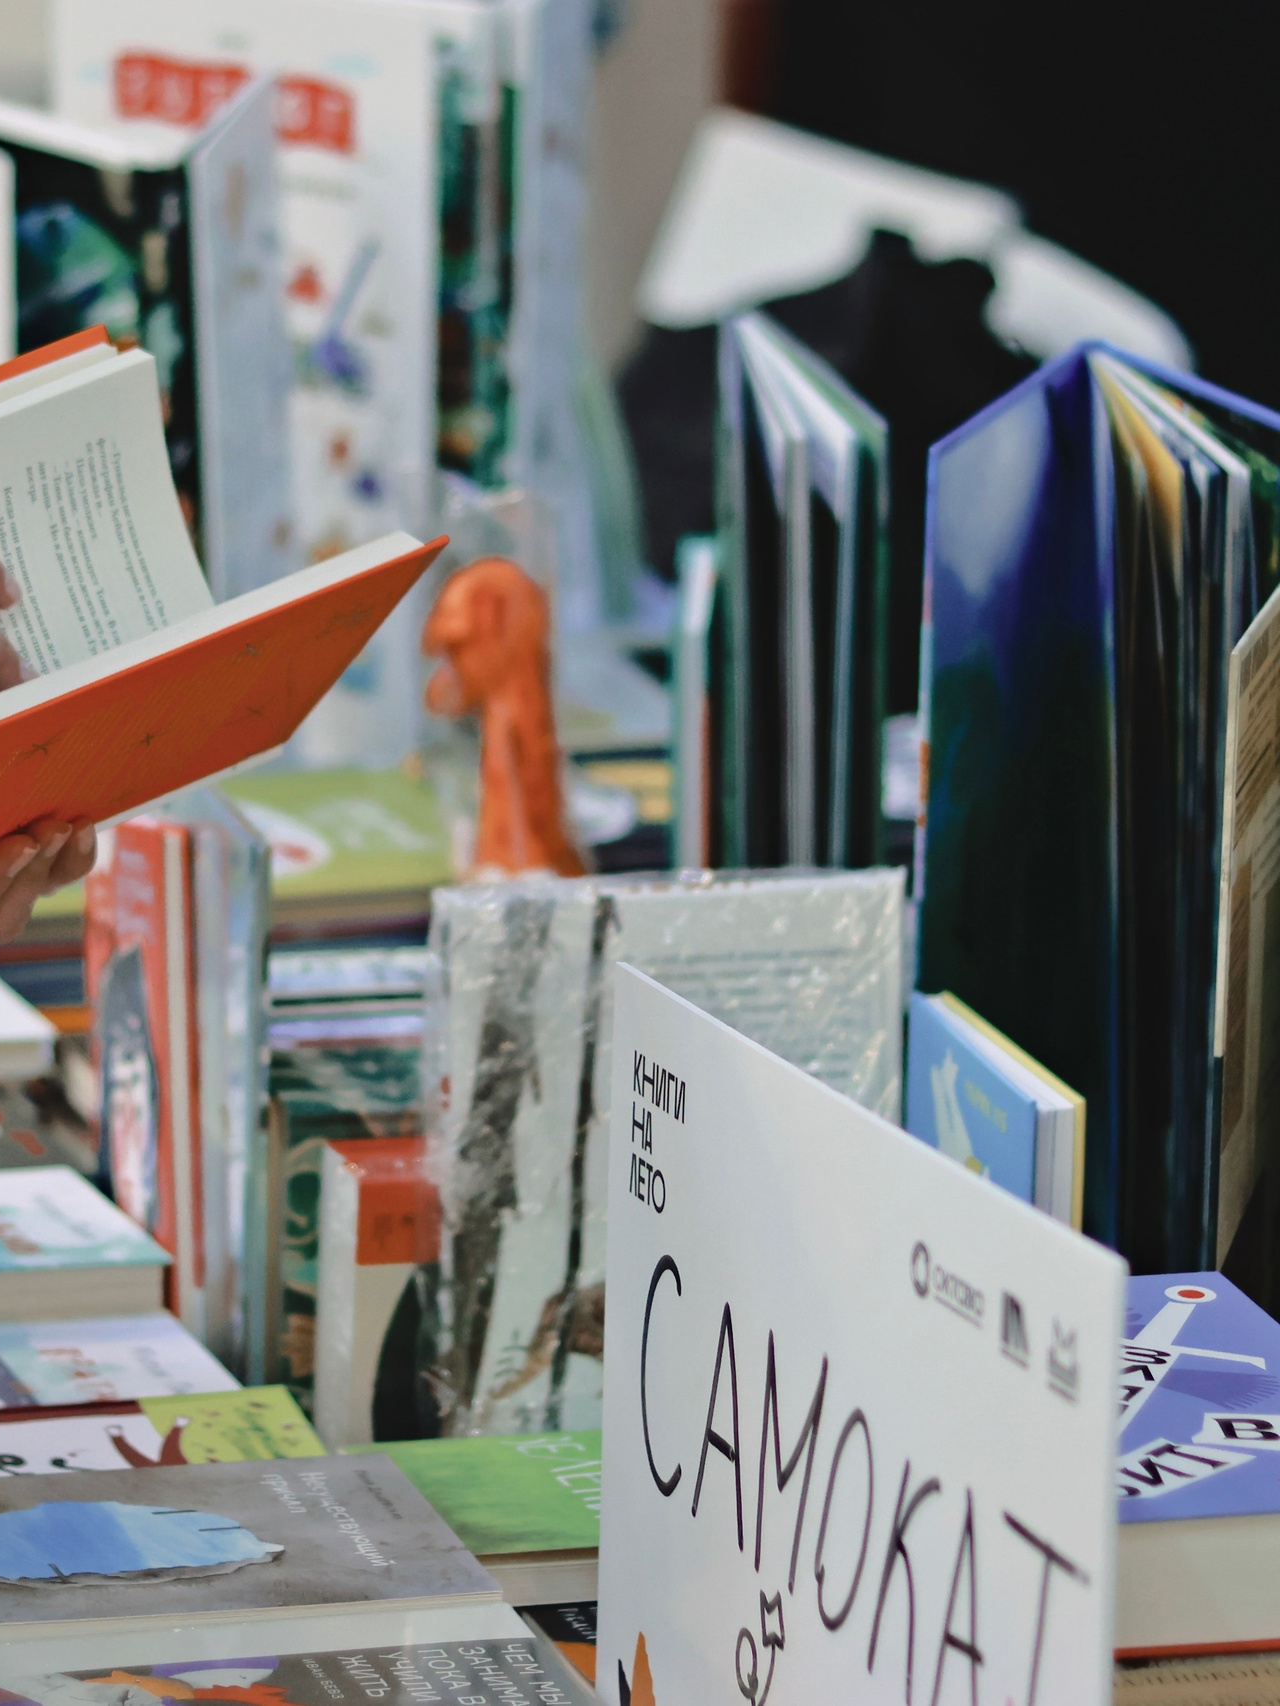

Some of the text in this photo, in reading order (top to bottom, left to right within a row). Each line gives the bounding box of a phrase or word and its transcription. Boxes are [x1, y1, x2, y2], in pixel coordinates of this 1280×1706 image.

[3, 486, 15, 519] Когда
[15, 546, 33, 593] наконец
[633, 1050, 686, 1124] КНИГИ
[631, 1101, 652, 1155] НА
[629, 1153, 666, 1213] ЛЕТО
[641, 1255, 1091, 1706] САМОКАТ
[298, 1472, 396, 1567] Несуществующий
[302, 1658, 345, 1699] ИВАН БЕВЗ
[337, 1655, 391, 1697] ЖИТЬ
[378, 1651, 442, 1702] УЧИЛИ
[418, 1649, 472, 1690] ПОКА
[501, 1643, 571, 1705] ЧЕМ МЫ
